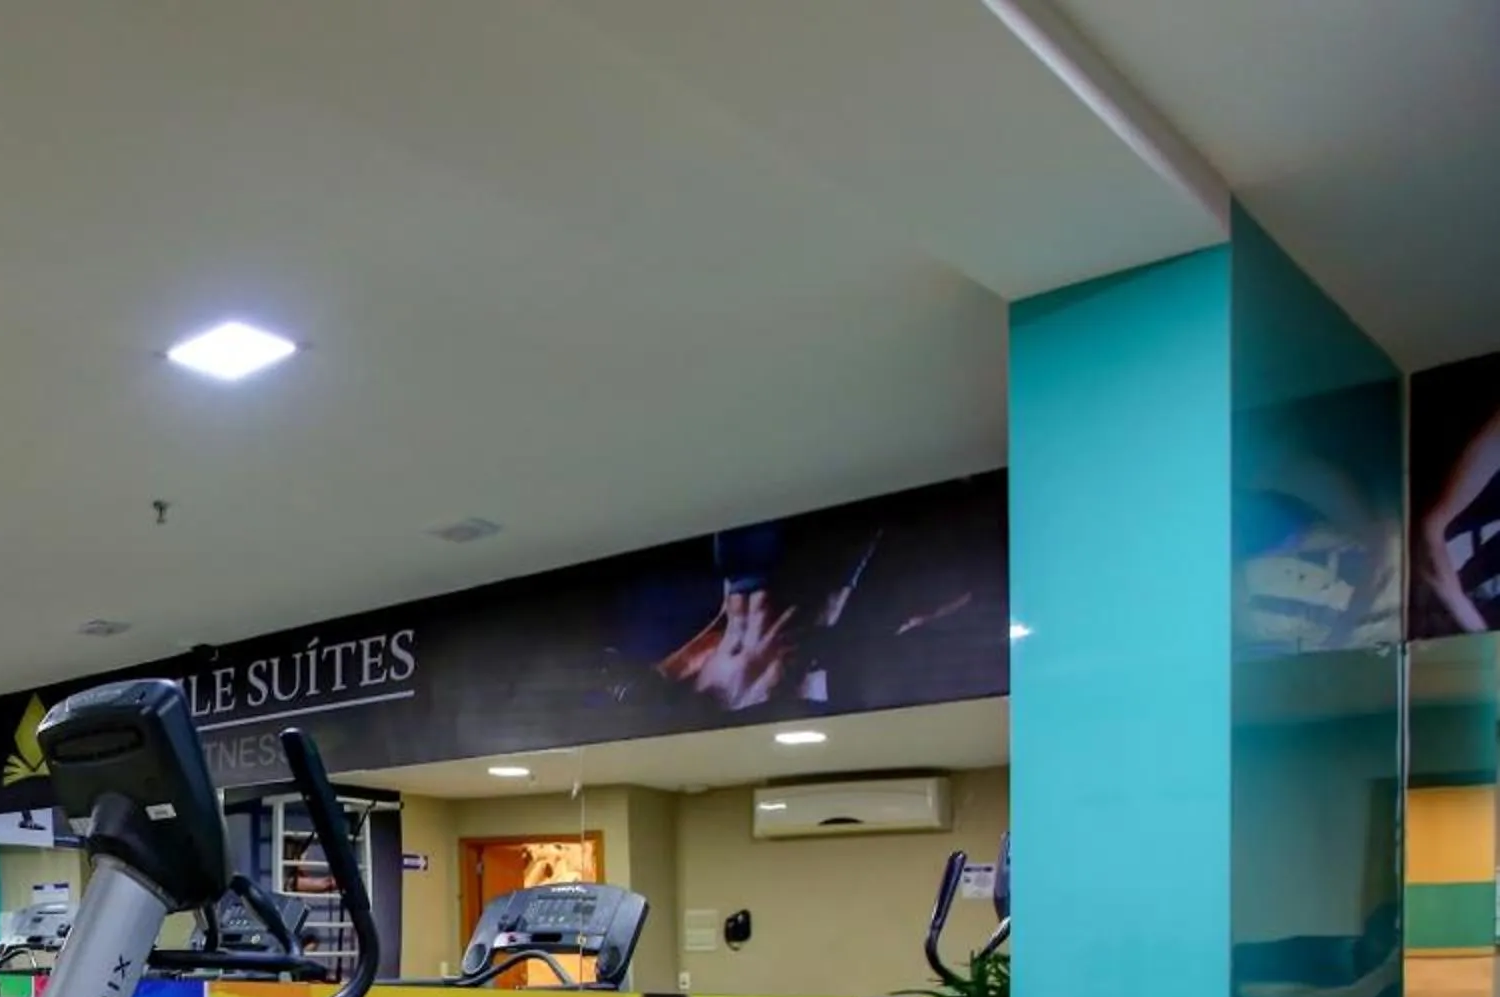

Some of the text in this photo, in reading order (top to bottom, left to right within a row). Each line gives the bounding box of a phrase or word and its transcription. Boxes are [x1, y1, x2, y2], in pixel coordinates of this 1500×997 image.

[180, 629, 415, 718] LE SUÍTES
[202, 733, 288, 773] TNES
